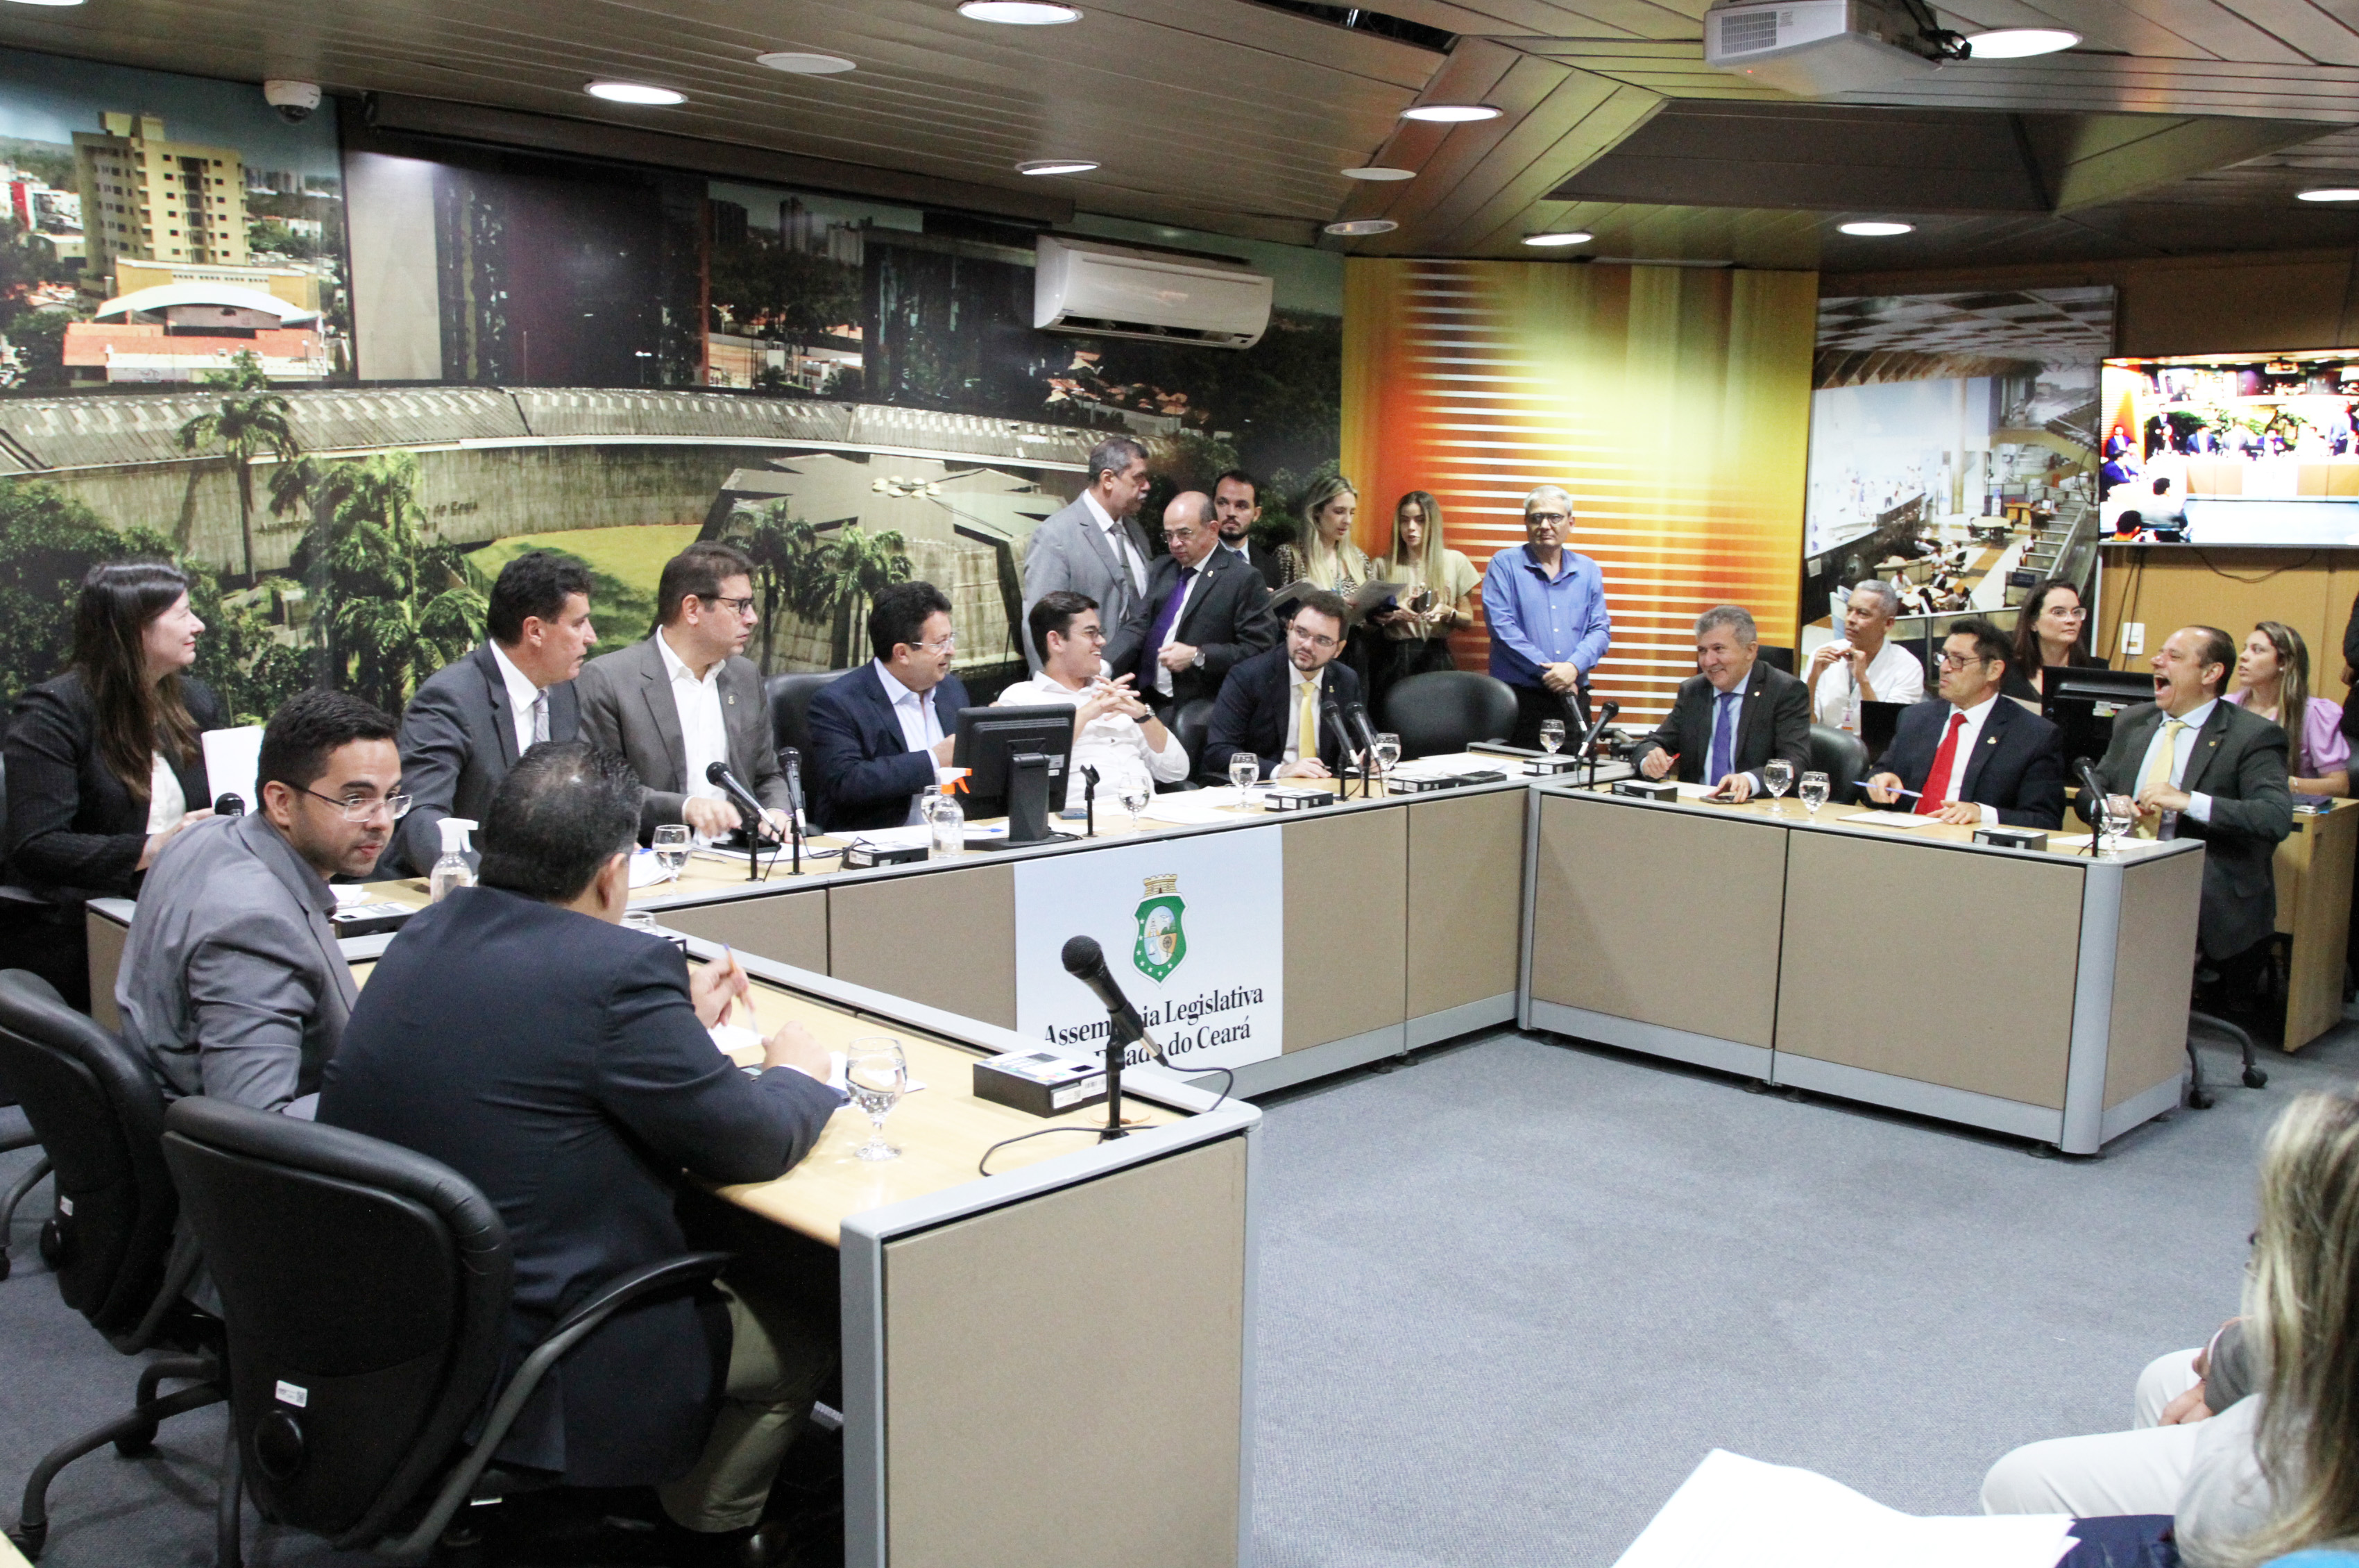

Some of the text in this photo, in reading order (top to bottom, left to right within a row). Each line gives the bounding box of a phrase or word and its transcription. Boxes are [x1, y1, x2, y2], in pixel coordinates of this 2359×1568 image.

[1045, 985, 1264, 1046] Assemia Legislativa
[1168, 1031, 1193, 1057] do
[1197, 1015, 1251, 1049] Ceará
